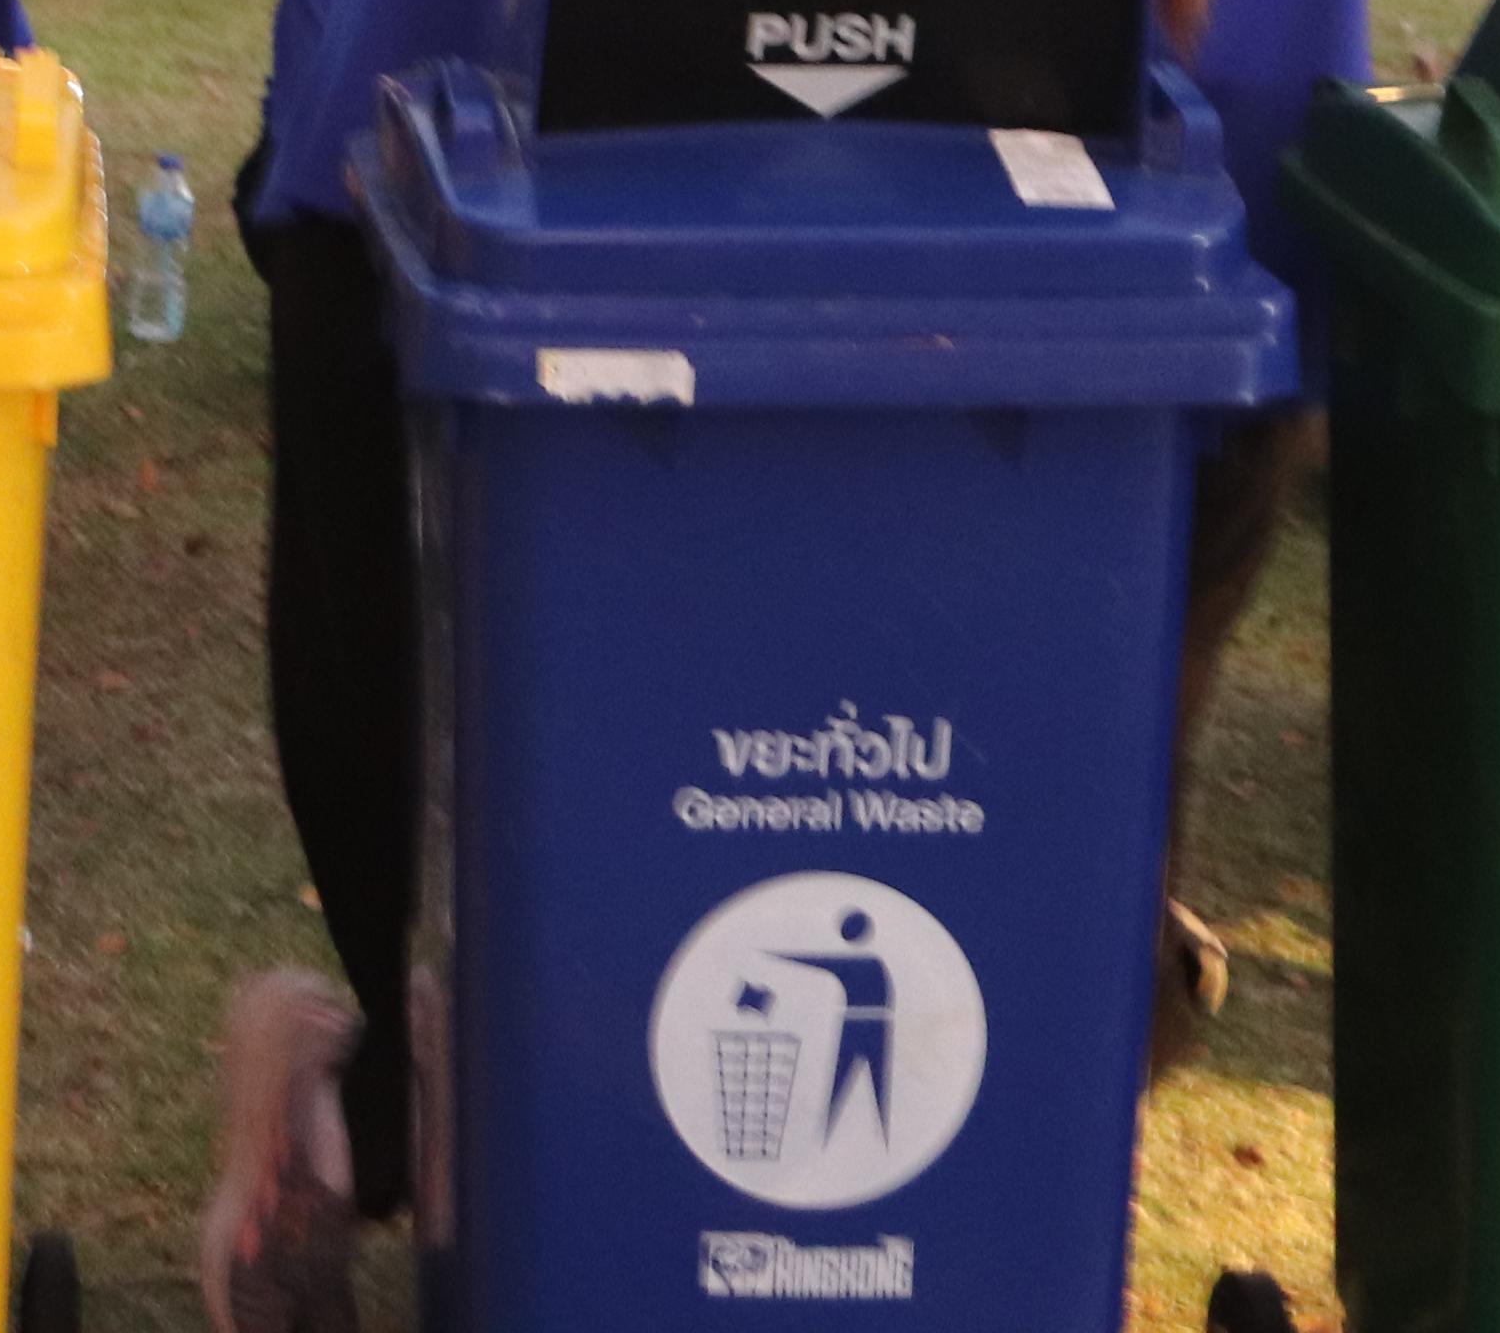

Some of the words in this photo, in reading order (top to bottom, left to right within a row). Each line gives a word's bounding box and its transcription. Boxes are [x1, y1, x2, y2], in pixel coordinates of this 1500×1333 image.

[745, 10, 915, 64] PUSH
[712, 699, 952, 781] ขยะทั่วไป
[673, 787, 841, 831] General
[851, 790, 985, 833] Waste
